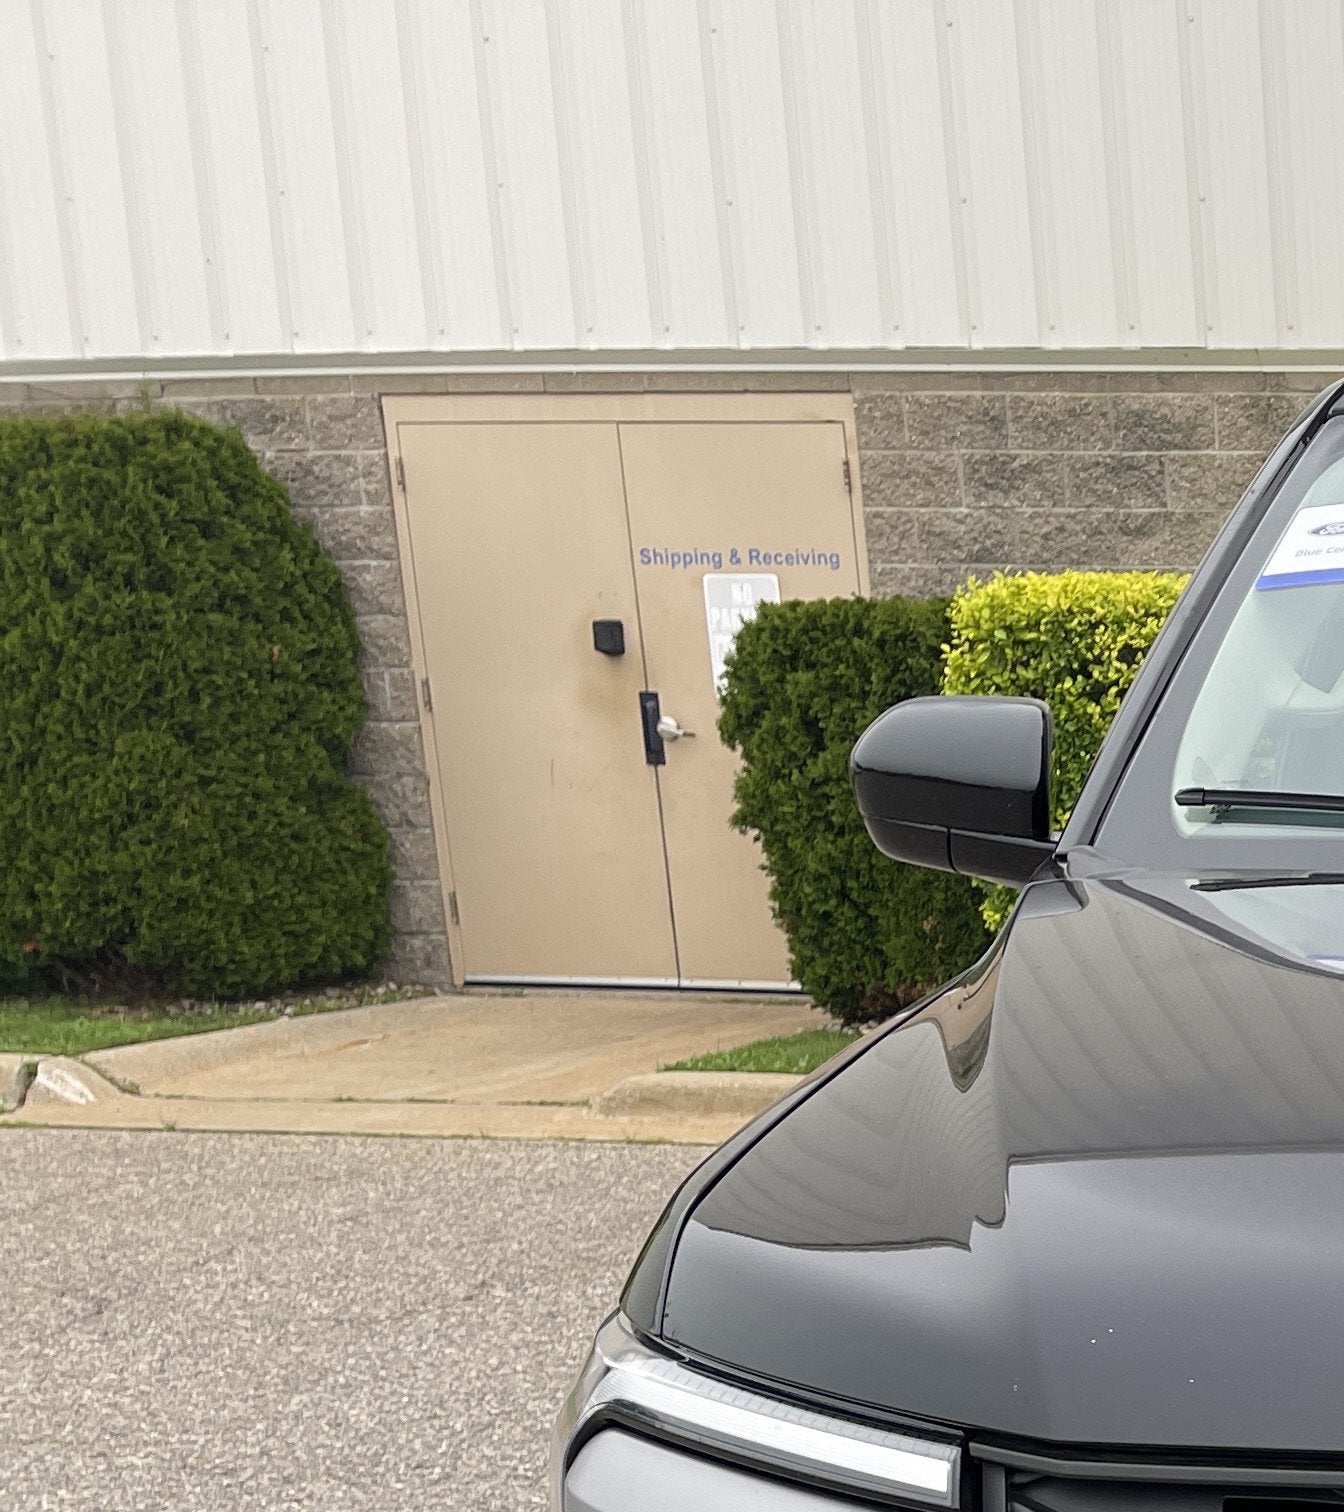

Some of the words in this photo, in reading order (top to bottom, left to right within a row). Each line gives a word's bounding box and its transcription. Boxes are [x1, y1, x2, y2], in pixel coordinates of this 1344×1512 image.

[639, 547, 722, 570] Shipping
[729, 548, 742, 565] &
[748, 548, 841, 570] Receiving
[1295, 548, 1322, 558] Blue
